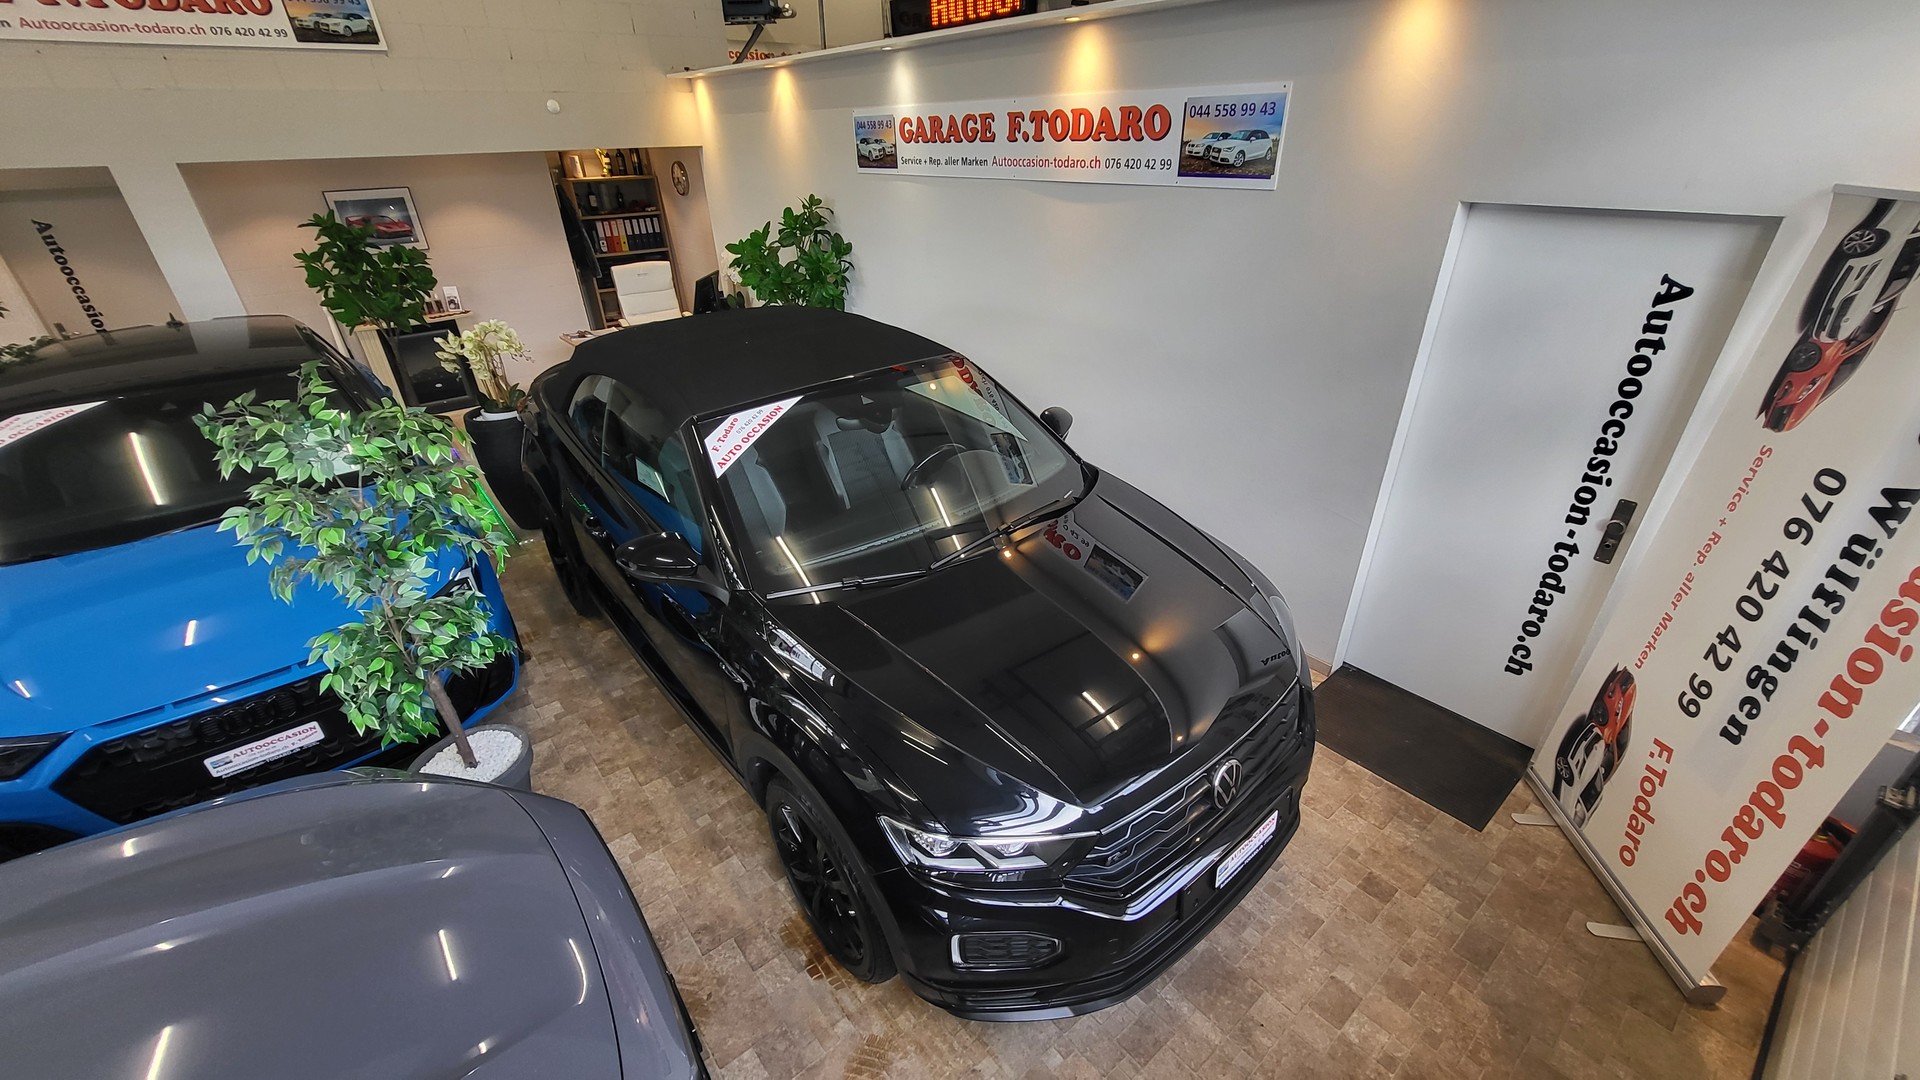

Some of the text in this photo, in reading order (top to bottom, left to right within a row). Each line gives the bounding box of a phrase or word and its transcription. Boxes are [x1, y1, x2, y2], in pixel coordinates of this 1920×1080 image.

[19, 16, 206, 35] Autooccasion-todaro.ch
[209, 26, 232, 36] 076
[235, 27, 256, 37] 420
[258, 28, 272, 38] 42
[274, 29, 288, 38] 99
[856, 119, 893, 130] 044 558 99 43
[899, 104, 1172, 144] GARAGE F.TODARO
[1189, 101, 1277, 118] 044 558 99 43
[901, 156, 922, 166] Service
[929, 157, 943, 168] Rep.
[944, 156, 960, 167] aller
[961, 156, 989, 167] Marken
[991, 156, 1101, 170] Autooccasion-todaro.ch
[1104, 158, 1122, 169] 076
[1124, 158, 1141, 170] 420
[1143, 158, 1157, 170] 42
[1159, 159, 1172, 171] 99
[8, 408, 75, 440] OCCASION
[711, 417, 739, 453] F. Todaro
[717, 405, 784, 469] AUTO OCCASION
[1504, 273, 1694, 676] Autooccasion-todaro.ch
[1634, 444, 1773, 669] Service + Rep. aller Marken
[1677, 467, 1847, 718] 076 420 42 99
[1719, 487, 1920, 745] Wülflingen
[232, 725, 318, 759] AUTOOCCASION
